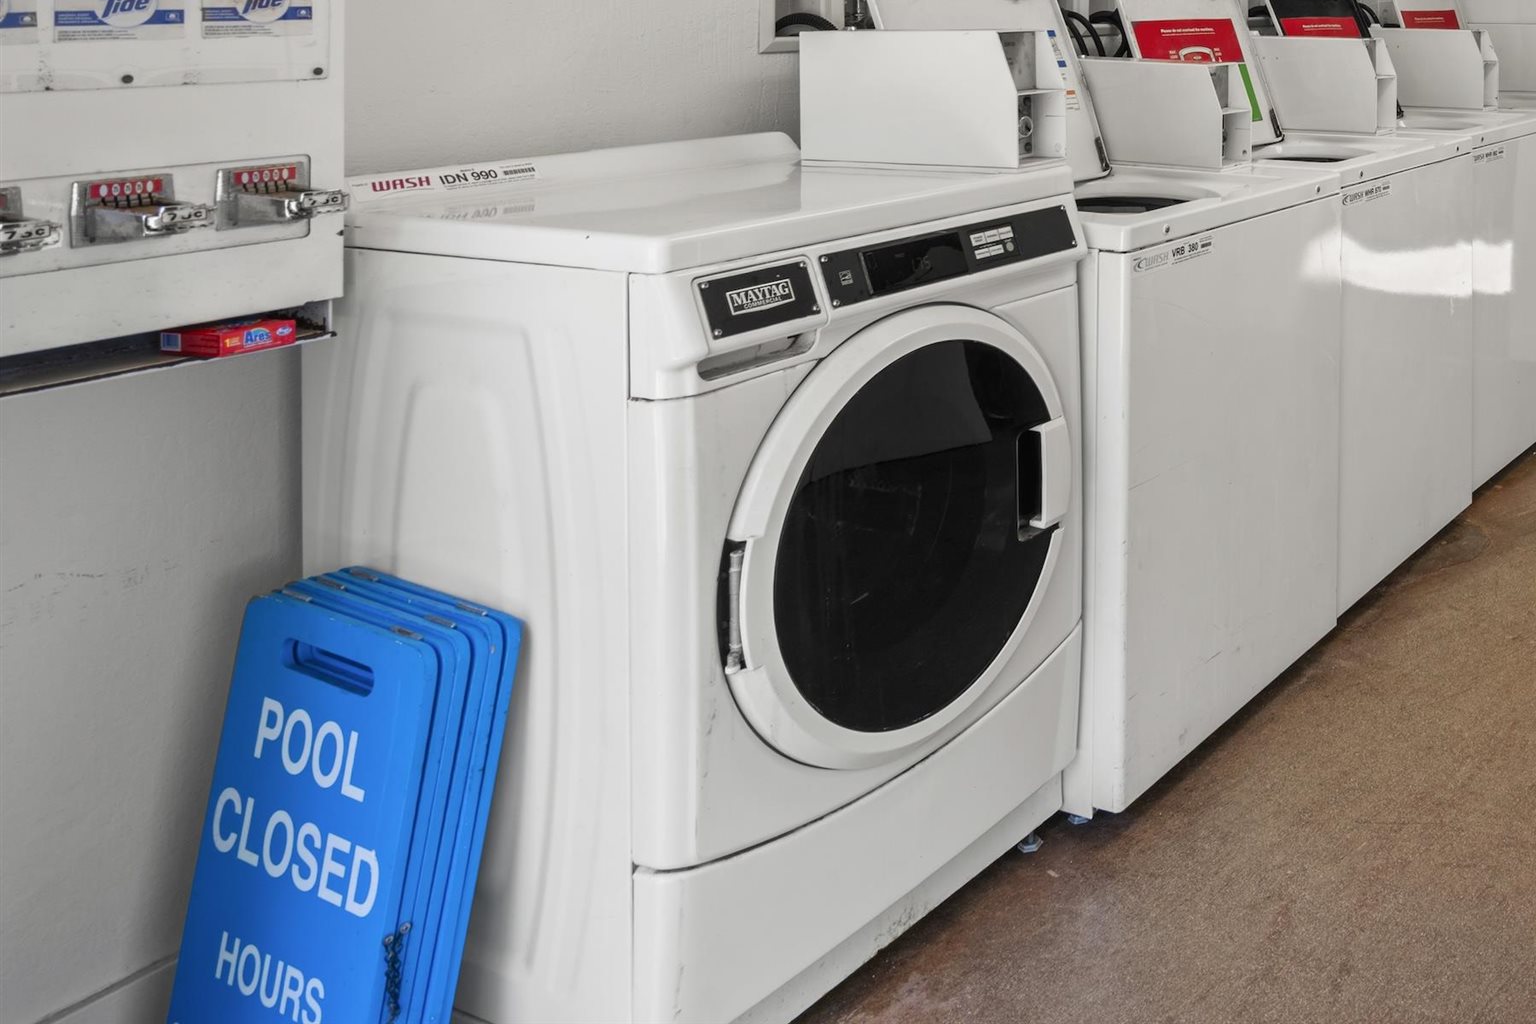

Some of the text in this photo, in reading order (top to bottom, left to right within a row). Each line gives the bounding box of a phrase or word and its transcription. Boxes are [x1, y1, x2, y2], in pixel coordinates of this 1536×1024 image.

[371, 176, 431, 192] WASH
[439, 172, 468, 186] IDN
[471, 169, 498, 181] 990
[1172, 246, 1185, 257] VRB
[731, 282, 789, 306] MAYTAG
[744, 296, 782, 309] COMMERCIAL
[244, 329, 272, 346] Ares
[253, 696, 366, 803] POOL
[212, 787, 380, 919] CLOSED
[215, 930, 326, 1024] HOURS
